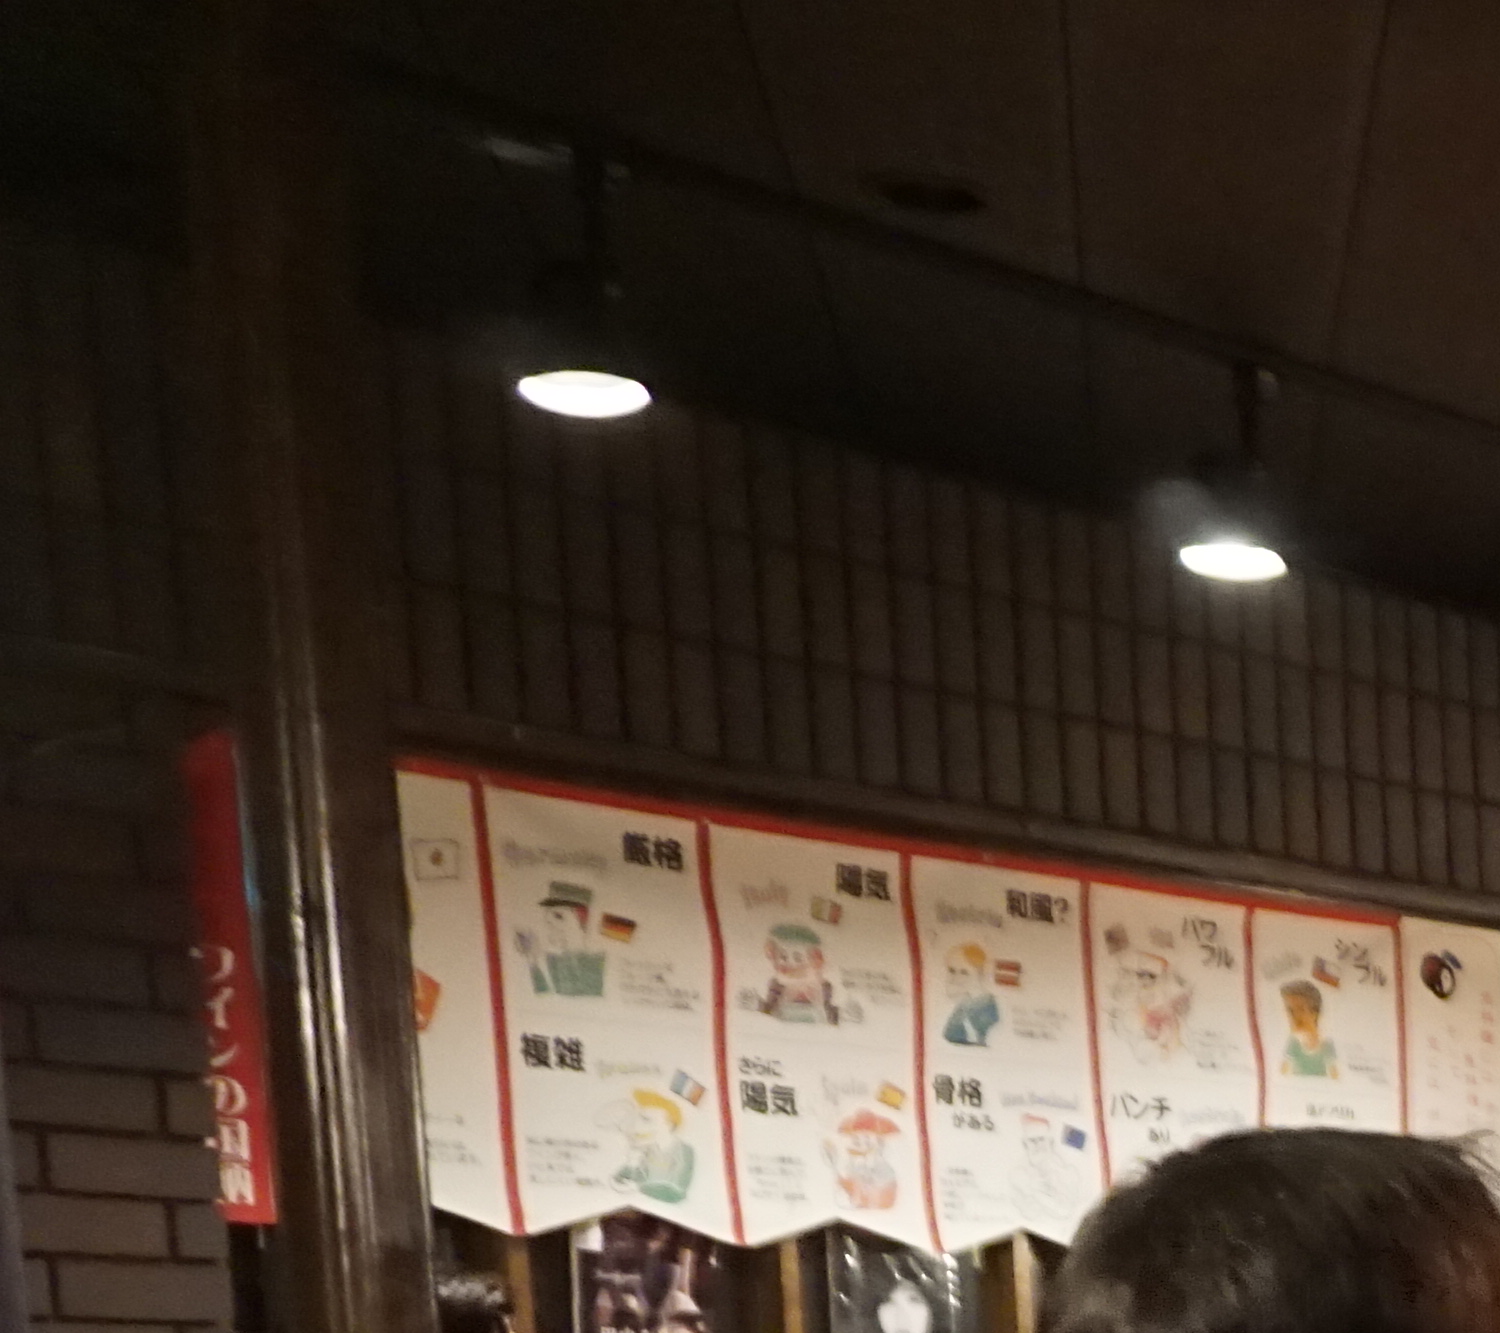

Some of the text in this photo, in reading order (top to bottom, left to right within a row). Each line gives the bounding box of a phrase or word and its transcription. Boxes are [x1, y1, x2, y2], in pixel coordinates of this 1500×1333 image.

[835, 862, 891, 901] 陽気
[520, 1031, 586, 1072] 複雑
[739, 1079, 799, 1117] 陽気
